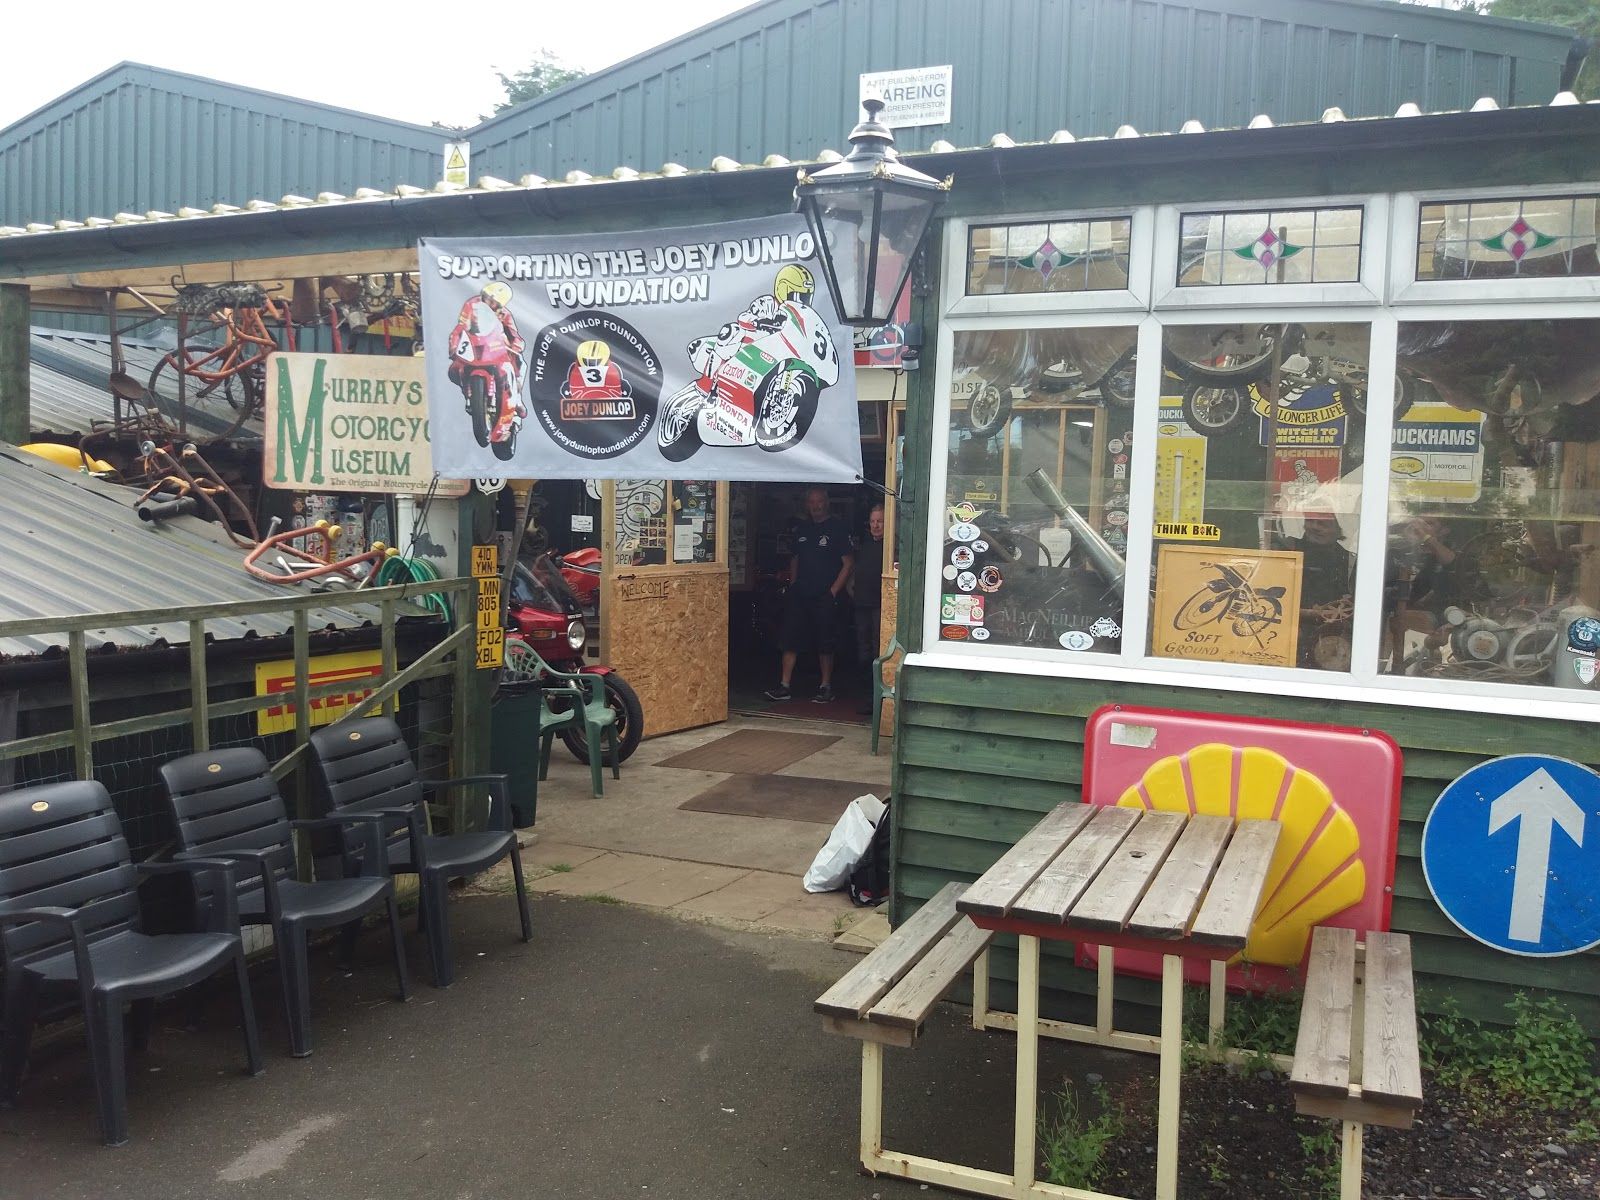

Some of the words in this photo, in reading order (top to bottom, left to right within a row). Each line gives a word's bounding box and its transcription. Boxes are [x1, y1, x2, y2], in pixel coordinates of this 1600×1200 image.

[888, 75, 924, 85] BUILDING
[925, 73, 947, 81] FROM
[880, 83, 946, 101] AREING
[913, 101, 945, 110] PRESTON
[437, 252, 592, 279] SUPPORTING
[593, 248, 647, 278] THE
[650, 242, 718, 273] JOEY
[545, 273, 710, 308] FOUNDATION
[458, 341, 469, 355] 3
[535, 358, 546, 382] THE
[543, 329, 557, 357] JOEY
[560, 318, 601, 334] DUNLOP
[603, 320, 657, 376] FOUNDATION
[586, 369, 602, 383] 3
[722, 363, 746, 379] Castrol
[565, 403, 590, 416] JOEY
[592, 403, 631, 416] DUNLOP
[720, 400, 748, 426] HONDA
[1277, 409, 1319, 423] LONGER
[1321, 404, 1345, 418] LIFE
[542, 409, 650, 455] www.joeydunlopfoundation.com
[1276, 428, 1318, 436] WITCH
[1320, 428, 1338, 436] TO
[331, 477, 347, 487] The
[348, 478, 381, 489] Original
[384, 480, 428, 491] Motorcycle
[1156, 524, 1188, 536] THINK
[477, 548, 492, 560] 410
[475, 561, 493, 574] YMN
[478, 581, 499, 596] MN
[622, 580, 670, 599] WELCOME
[484, 612, 491, 626] U
[477, 629, 502, 646] F02
[1184, 631, 1224, 644] SOFT
[1164, 641, 1220, 656] GROUND
